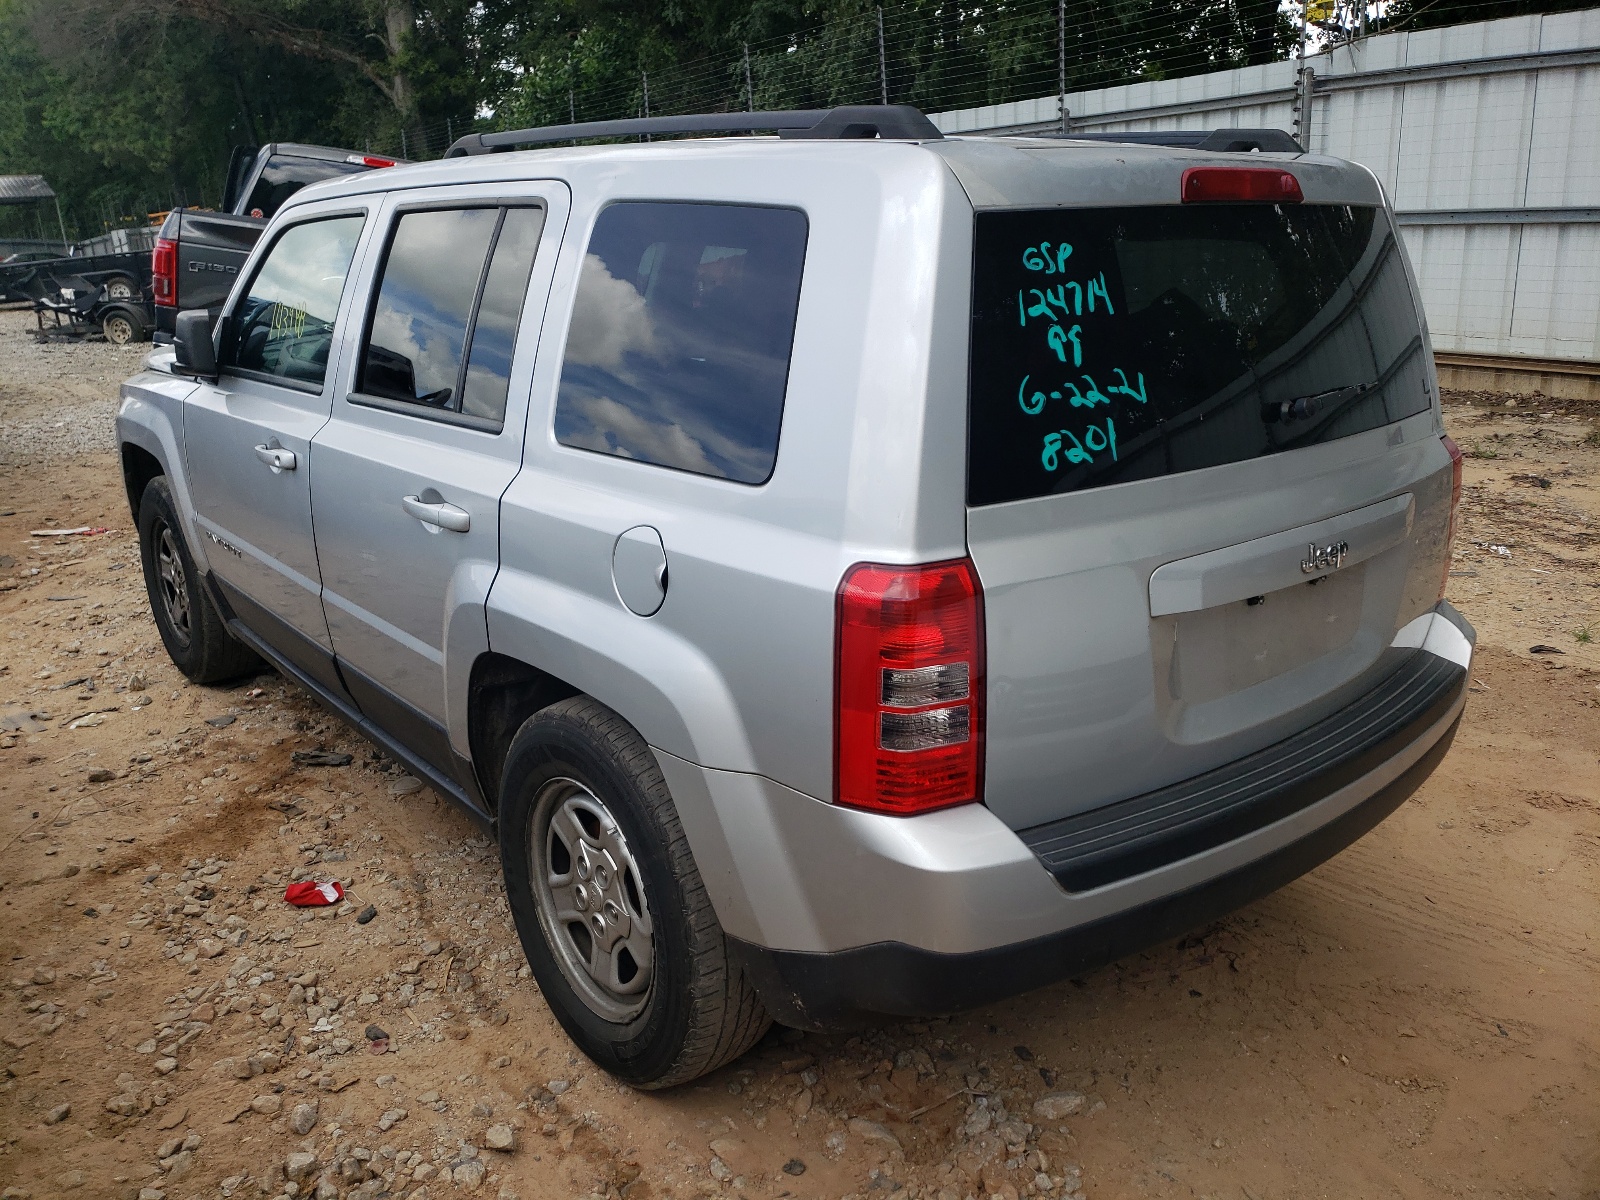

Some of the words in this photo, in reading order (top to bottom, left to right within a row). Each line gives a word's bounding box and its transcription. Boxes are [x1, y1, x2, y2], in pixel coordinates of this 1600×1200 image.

[1022, 241, 1073, 274] GSP
[1018, 271, 1115, 327] 124714
[1018, 367, 1147, 415] 6-22-21
[1041, 416, 1118, 471] 8201
[1301, 540, 1349, 574] Jeep
